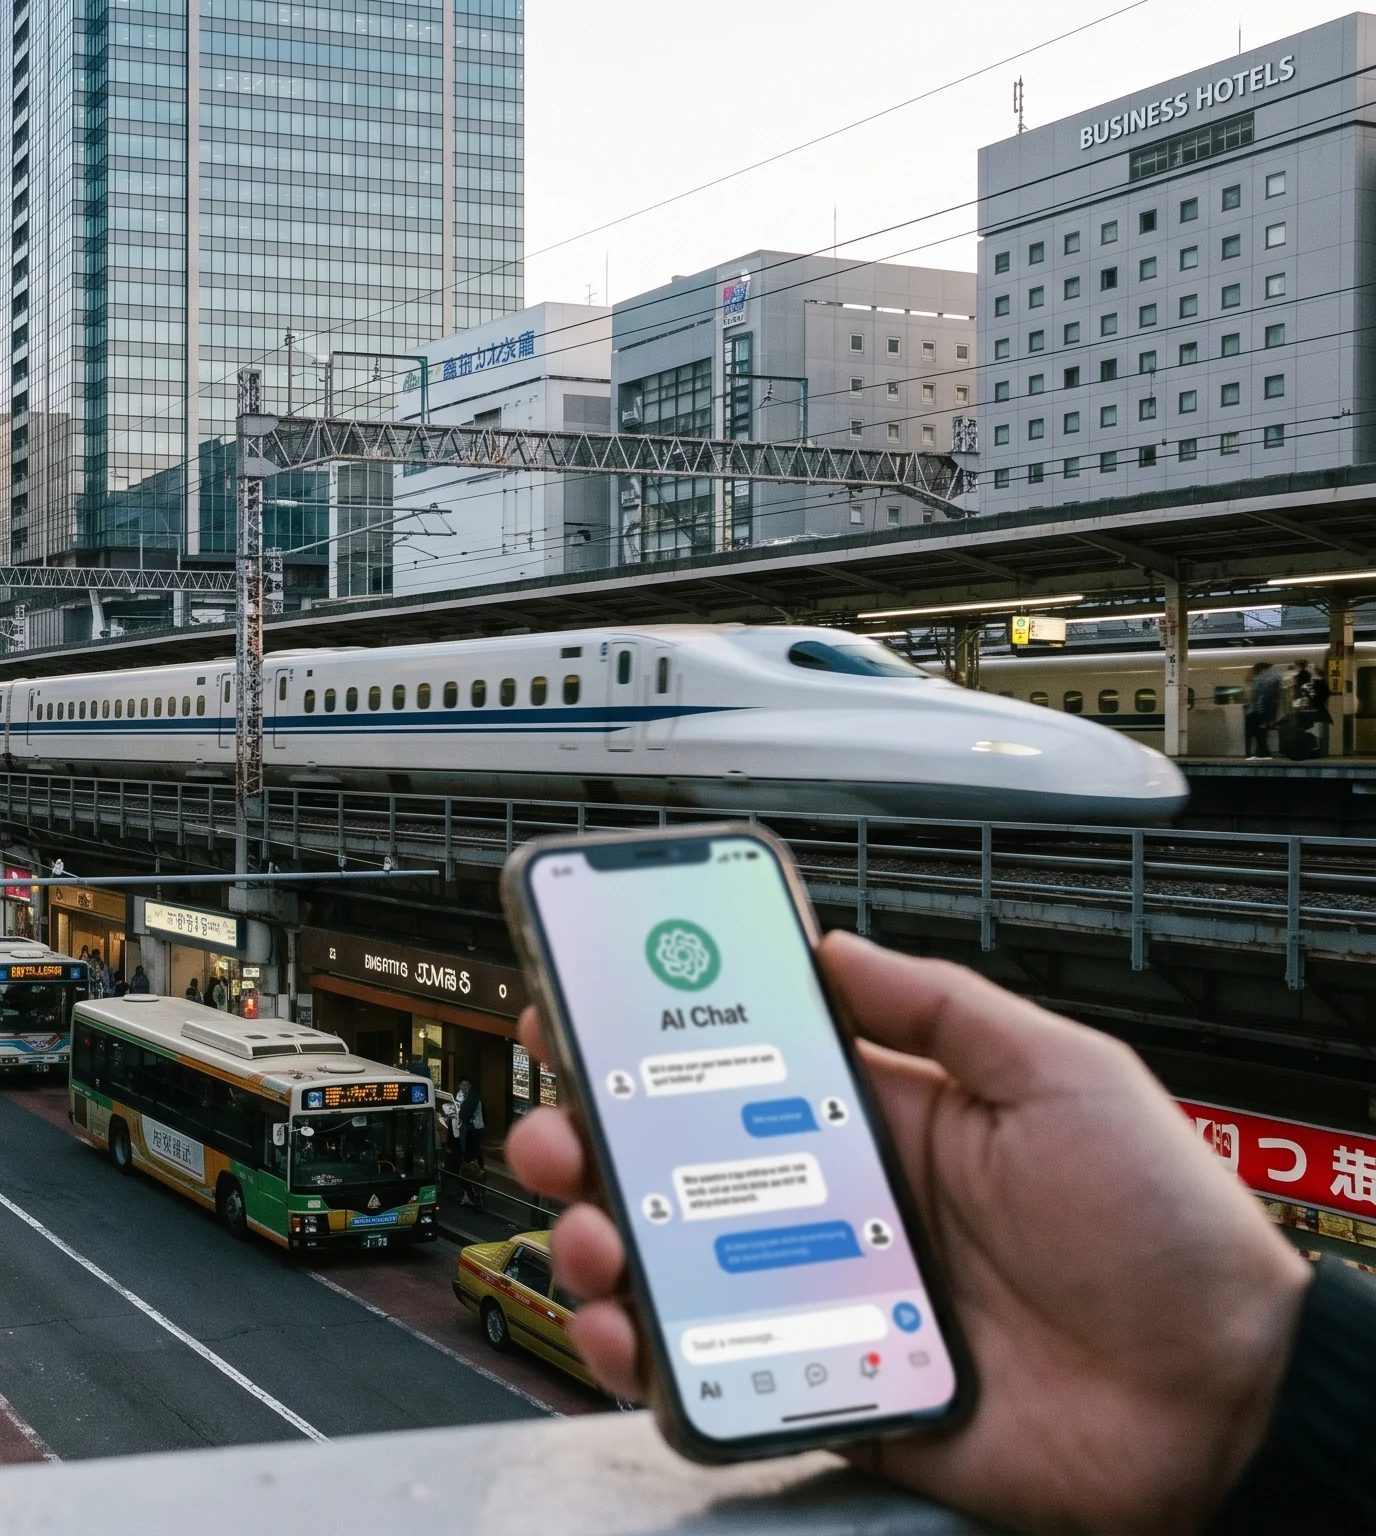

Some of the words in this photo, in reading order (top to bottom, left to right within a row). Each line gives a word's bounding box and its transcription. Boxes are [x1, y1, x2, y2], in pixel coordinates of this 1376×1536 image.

[1080, 92, 1189, 150] BUSINESS
[1196, 55, 1296, 110] HOTELS
[660, 1009, 686, 1032] AI
[690, 1002, 749, 1028] Chat
